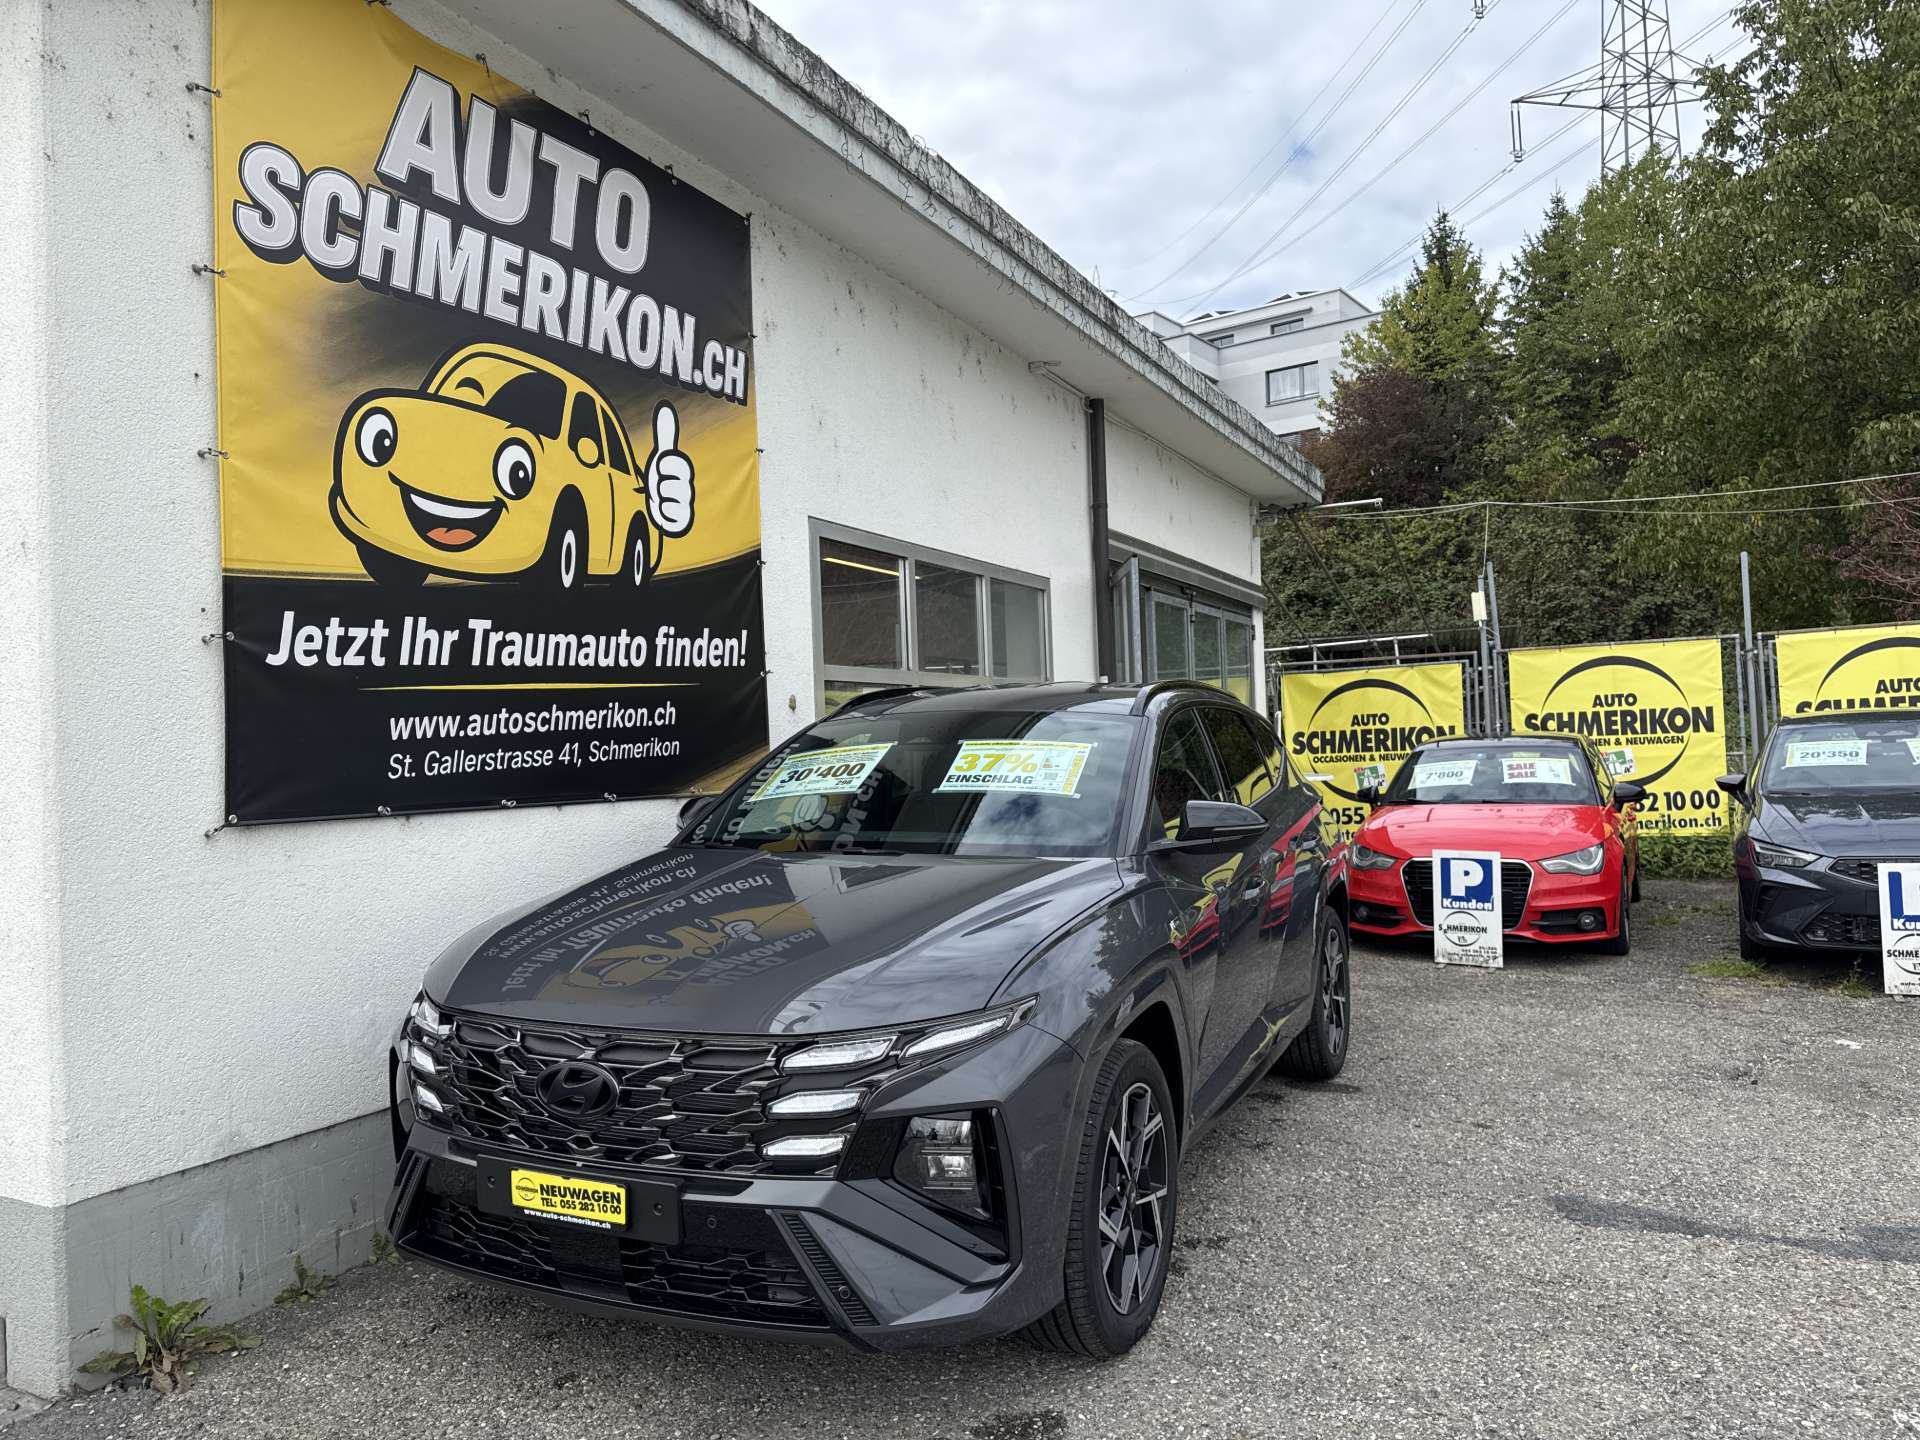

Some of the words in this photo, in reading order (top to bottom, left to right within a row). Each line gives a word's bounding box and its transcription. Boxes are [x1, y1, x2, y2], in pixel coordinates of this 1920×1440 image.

[377, 68, 651, 274] AUTO
[236, 143, 747, 400] SCHMERIKON.CH
[265, 610, 389, 667] Jetzt
[400, 616, 459, 667] Ihr
[467, 618, 643, 667] Traumauto
[655, 626, 748, 667] finden!
[1592, 693, 1637, 708] AUTO
[389, 701, 677, 741] www.autoschmerikon.ch
[1351, 712, 1390, 727] AUTO
[1524, 706, 1715, 736] SCHMERIKON
[1614, 737, 1622, 745] &
[1625, 735, 1685, 746] NEUWAGEN
[387, 753, 417, 780] St.
[424, 743, 554, 776] Gallerstrasse
[558, 742, 583, 767] 41,
[588, 738, 680, 763] Schmerikon
[954, 752, 1038, 773] 37%
[1312, 754, 1367, 764] OCCASIONEN
[1369, 753, 1376, 762] &
[1800, 750, 1860, 759] 20'350
[780, 763, 866, 784] 30'400
[1506, 762, 1536, 771] SALE
[1507, 771, 1538, 779] SALE
[945, 774, 1034, 785] EINSCHLAG
[1663, 791, 1687, 811] 10
[1690, 789, 1721, 810] 00
[1330, 807, 1365, 825] 055
[1449, 860, 1484, 897] P
[1443, 898, 1492, 911] Kunden
[539, 1184, 622, 1205] NEUWAGEN
[540, 1197, 558, 1208] TEL:
[559, 1199, 577, 1210] 055
[578, 1201, 595, 1212] 282
[598, 1203, 608, 1213] 10
[609, 1205, 622, 1215] 00
